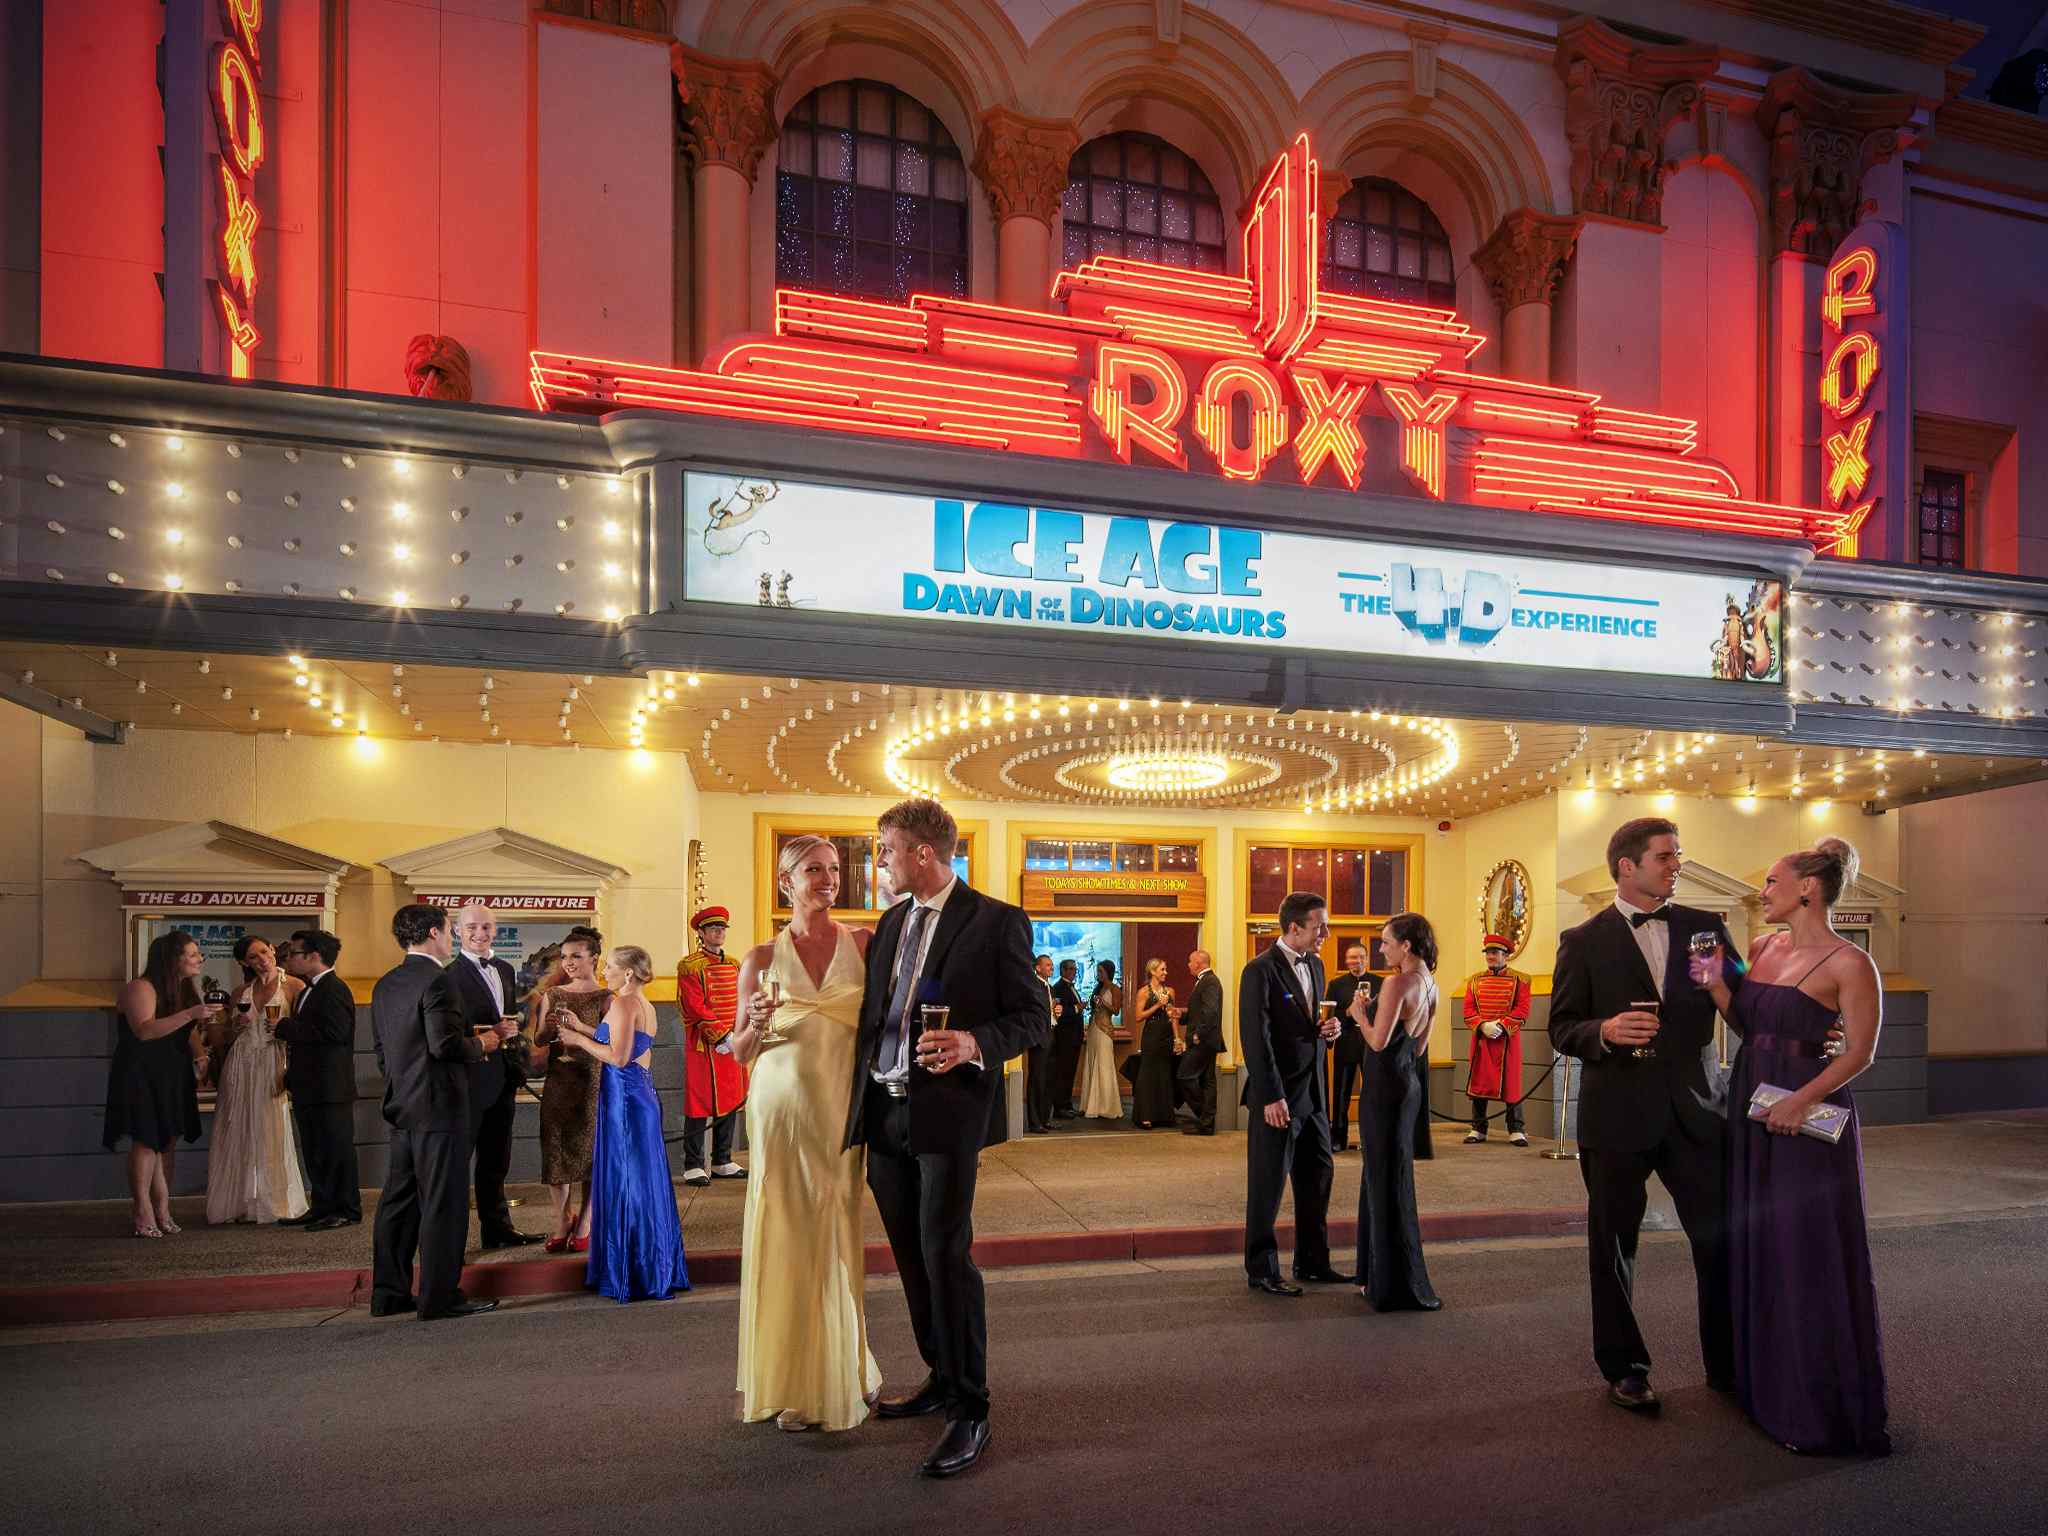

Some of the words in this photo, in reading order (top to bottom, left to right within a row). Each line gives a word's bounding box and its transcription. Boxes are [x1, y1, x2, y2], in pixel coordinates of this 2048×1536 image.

[1820, 247, 1880, 559] ROXY
[1088, 343, 1468, 500] ROXY
[933, 498, 1085, 583] ICE
[1098, 516, 1263, 598] AGE
[903, 572, 1033, 620] DAWN
[1040, 596, 1063, 609] OF
[1339, 592, 1391, 616] THE
[1390, 562, 1512, 648] 4D
[1511, 607, 1658, 639] EXPERIENCE
[1035, 607, 1065, 622] THE
[1070, 587, 1287, 640] DINOSAURS
[137, 892, 175, 905] THE
[179, 892, 204, 905] 4D
[207, 893, 318, 906] ADVENTURE
[1077, 877, 1127, 890] SHOWTIMES
[1139, 879, 1161, 890] NEXT
[1162, 879, 1189, 891] SHOW
[426, 896, 460, 907] THE
[464, 896, 486, 906] 4D
[490, 896, 589, 909] ADVENTURE
[1832, 913, 1869, 923] ENTURE
